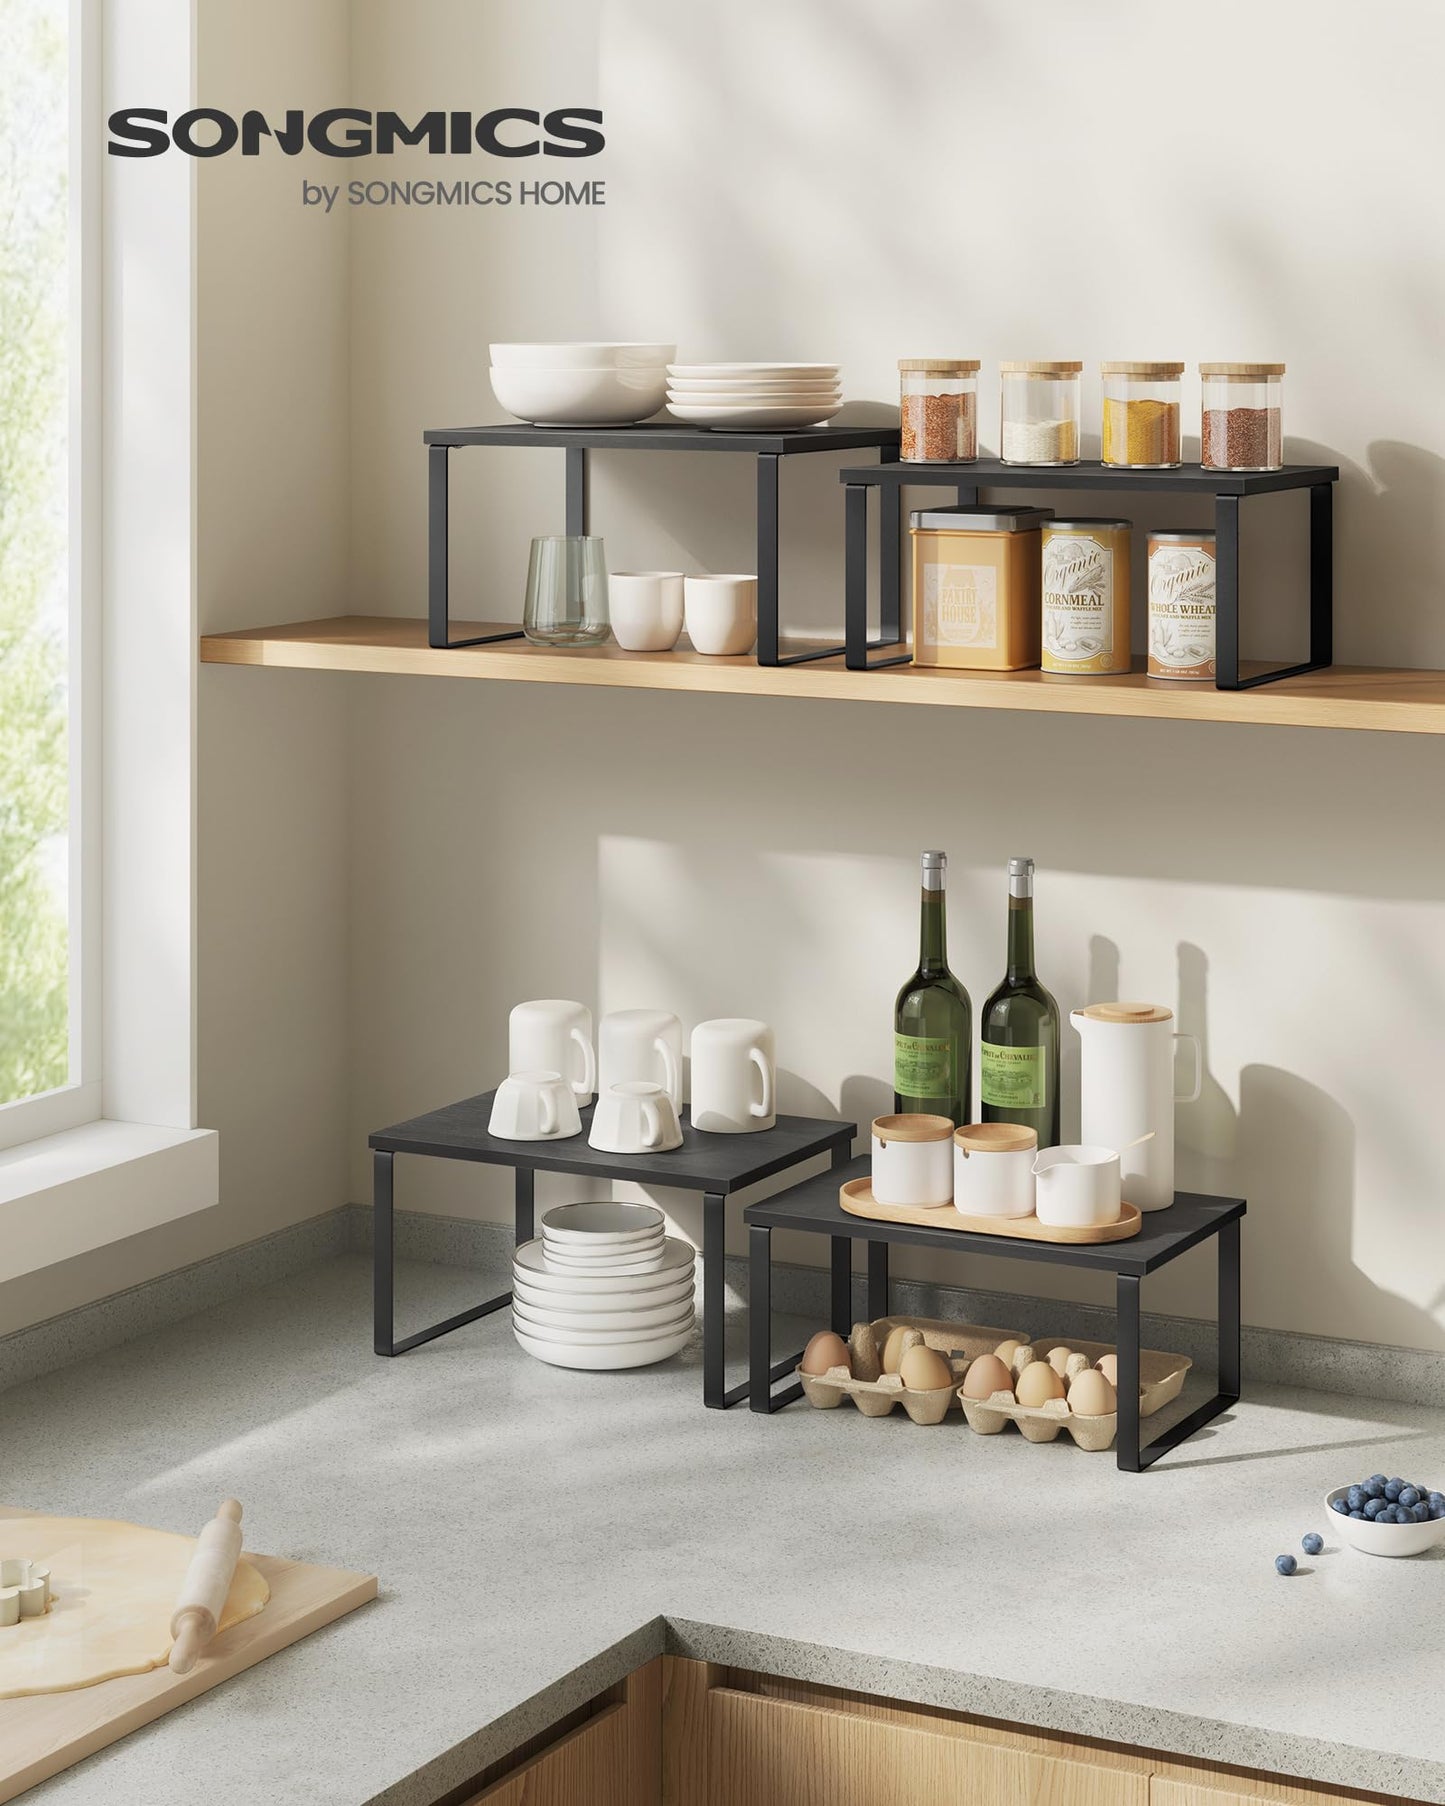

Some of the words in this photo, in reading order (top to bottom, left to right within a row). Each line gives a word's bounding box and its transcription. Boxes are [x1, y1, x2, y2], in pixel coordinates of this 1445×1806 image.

[1044, 549, 1101, 590] Organic
[1150, 560, 1209, 600] Organic
[1045, 591, 1105, 607] CORNMEAL
[1151, 601, 1179, 614] WHOLE
[1180, 604, 1216, 615] WHEAT
[941, 605, 977, 624] HOUSE
